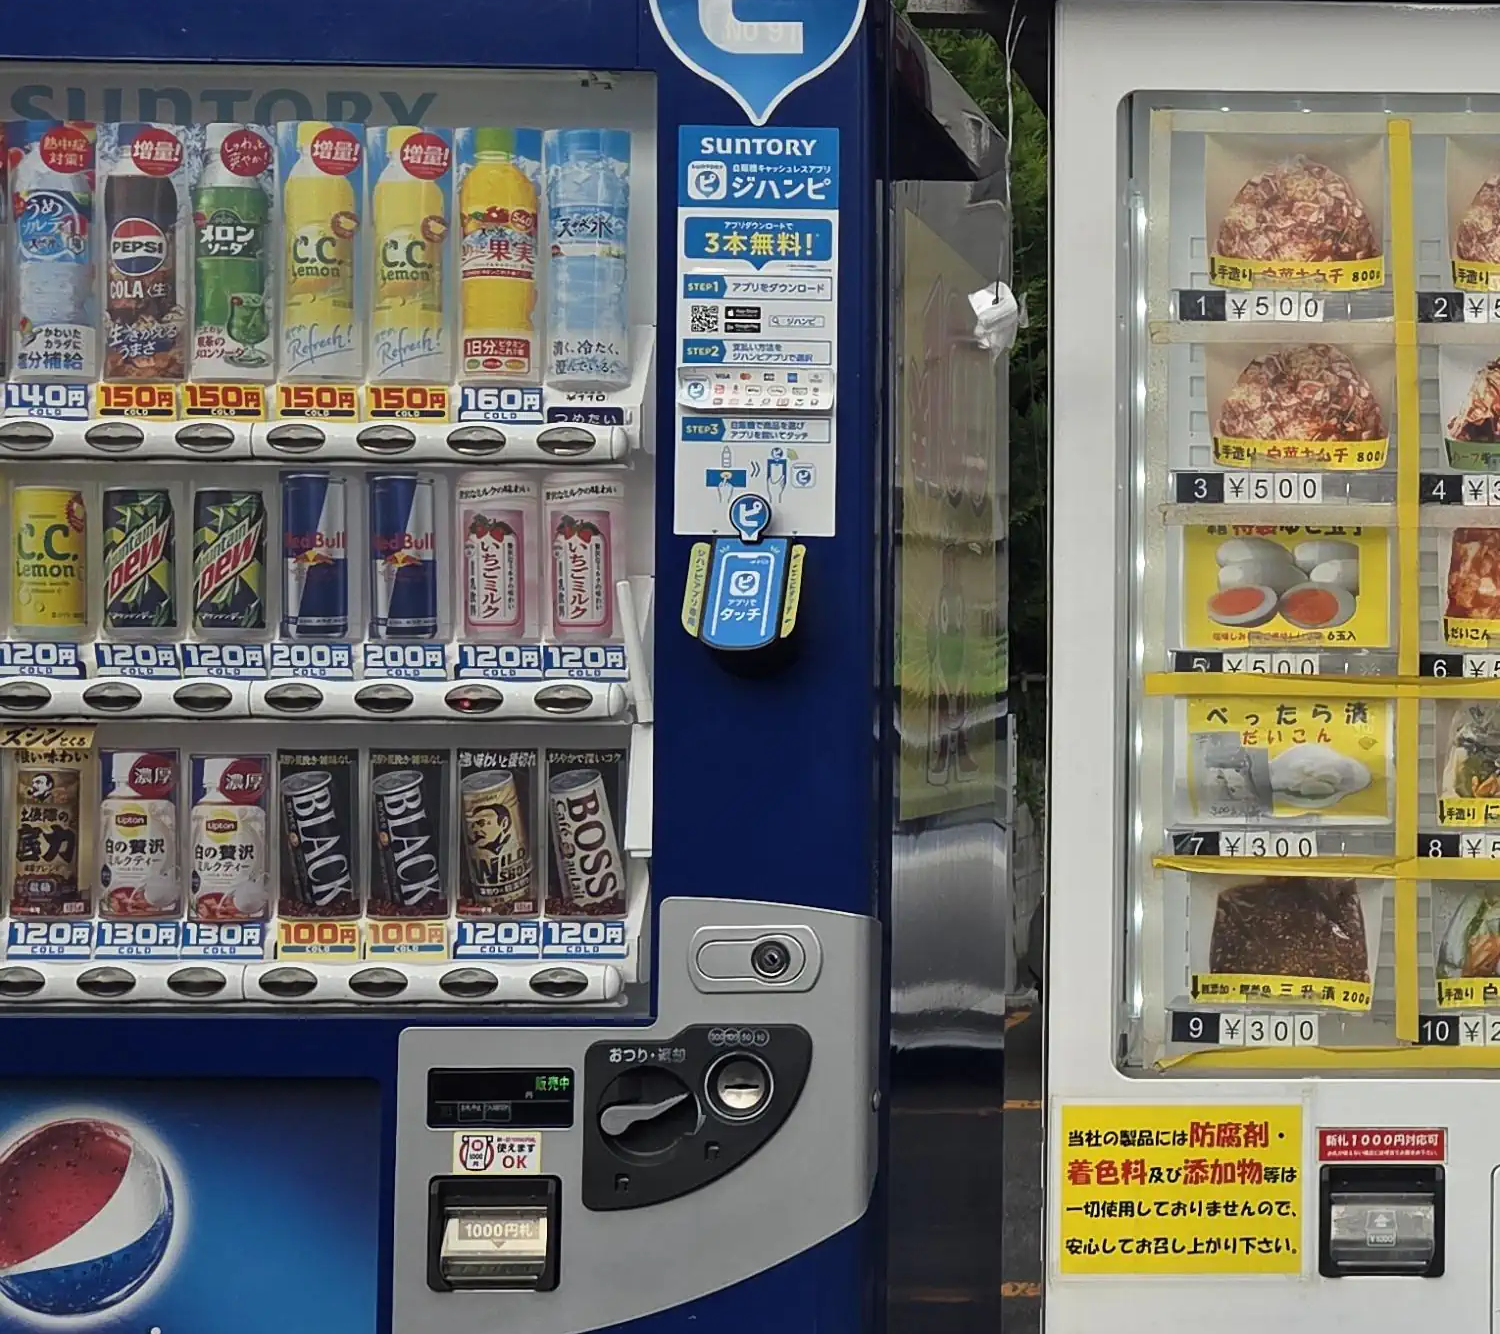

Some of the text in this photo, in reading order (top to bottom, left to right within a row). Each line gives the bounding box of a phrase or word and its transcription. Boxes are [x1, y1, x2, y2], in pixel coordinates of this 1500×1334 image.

[133, 139, 182, 163] 増量!
[314, 137, 359, 163] 増量!
[403, 142, 449, 167] 増量!
[701, 137, 817, 156] SUNTORY
[731, 175, 832, 200] ジハンピ
[200, 227, 255, 244] メロン
[557, 216, 615, 239] 天然水
[724, 221, 794, 230] アプリダウンロードで
[112, 238, 163, 255] PEPSI
[704, 231, 813, 257] 3本無料!
[110, 281, 144, 299] COLA
[731, 282, 825, 293] アプリをダウンロード
[1197, 296, 1318, 319] 1 ¥500
[1434, 298, 1448, 318] 2
[687, 345, 720, 356] STEP2
[732, 353, 813, 362] ジハンピアプリで選択
[6, 384, 85, 407] 140円
[100, 386, 173, 408] 150円
[185, 386, 261, 408] 150円
[280, 386, 354, 408] 150円
[369, 387, 446, 410] 150円
[464, 389, 540, 411] 160円
[28, 408, 62, 417] COLD
[686, 424, 720, 435] STEP3
[1194, 478, 1317, 498] 3 ¥500
[1432, 479, 1447, 499] 4
[740, 501, 762, 527] ピ
[17, 524, 79, 560] C.C.
[404, 532, 434, 550] Bull
[481, 541, 501, 618] いちごミルク
[569, 542, 589, 619] いちごミルク
[720, 608, 761, 621] タッチ
[1327, 631, 1356, 641] 6玉入
[0, 643, 76, 665] 120円
[101, 645, 175, 665] 120円
[186, 645, 262, 665] 120円
[272, 645, 349, 666] 200円
[366, 646, 442, 666] 200円
[463, 646, 539, 666] 120円
[549, 646, 623, 667] 120円
[292, 668, 326, 676] COLD
[1227, 658, 1315, 674] ¥500
[1433, 660, 1447, 677] 6
[1206, 702, 1368, 725] べったら漬
[1243, 728, 1332, 745] だいこん
[134, 767, 172, 785] 濃厚
[225, 773, 262, 790] 濃厚
[116, 816, 146, 825] Lipton
[207, 821, 236, 831] Lipton
[292, 786, 352, 906] BLACK
[383, 786, 442, 906] BLACK
[567, 789, 617, 898] BOSS
[1190, 837, 1312, 857] 7 ¥300
[1428, 840, 1443, 857] 8
[14, 923, 89, 944] 120円
[102, 923, 175, 944] 130円
[187, 924, 260, 944] 130円
[281, 923, 355, 944] 100円
[370, 924, 444, 944] 100円
[462, 923, 537, 944] 120円
[550, 923, 623, 944] 120円
[118, 946, 151, 954] COLD
[1189, 1018, 1314, 1041] 9 ¥300
[1423, 1020, 1450, 1037] 10
[609, 1047, 686, 1063] おつり・返却
[535, 1075, 570, 1091] 販売中
[1068, 1121, 1286, 1149] 当社の製品には防腐剤・
[497, 1143, 535, 1153] 使えます
[502, 1156, 527, 1169] OK
[1067, 1159, 1297, 1186] 着色料及び添加物等は
[1066, 1199, 1298, 1218] 一切使用しておりませんので、
[464, 1222, 533, 1237] 1000円札
[1065, 1237, 1298, 1256] 安心してお召し上がり下さい。
